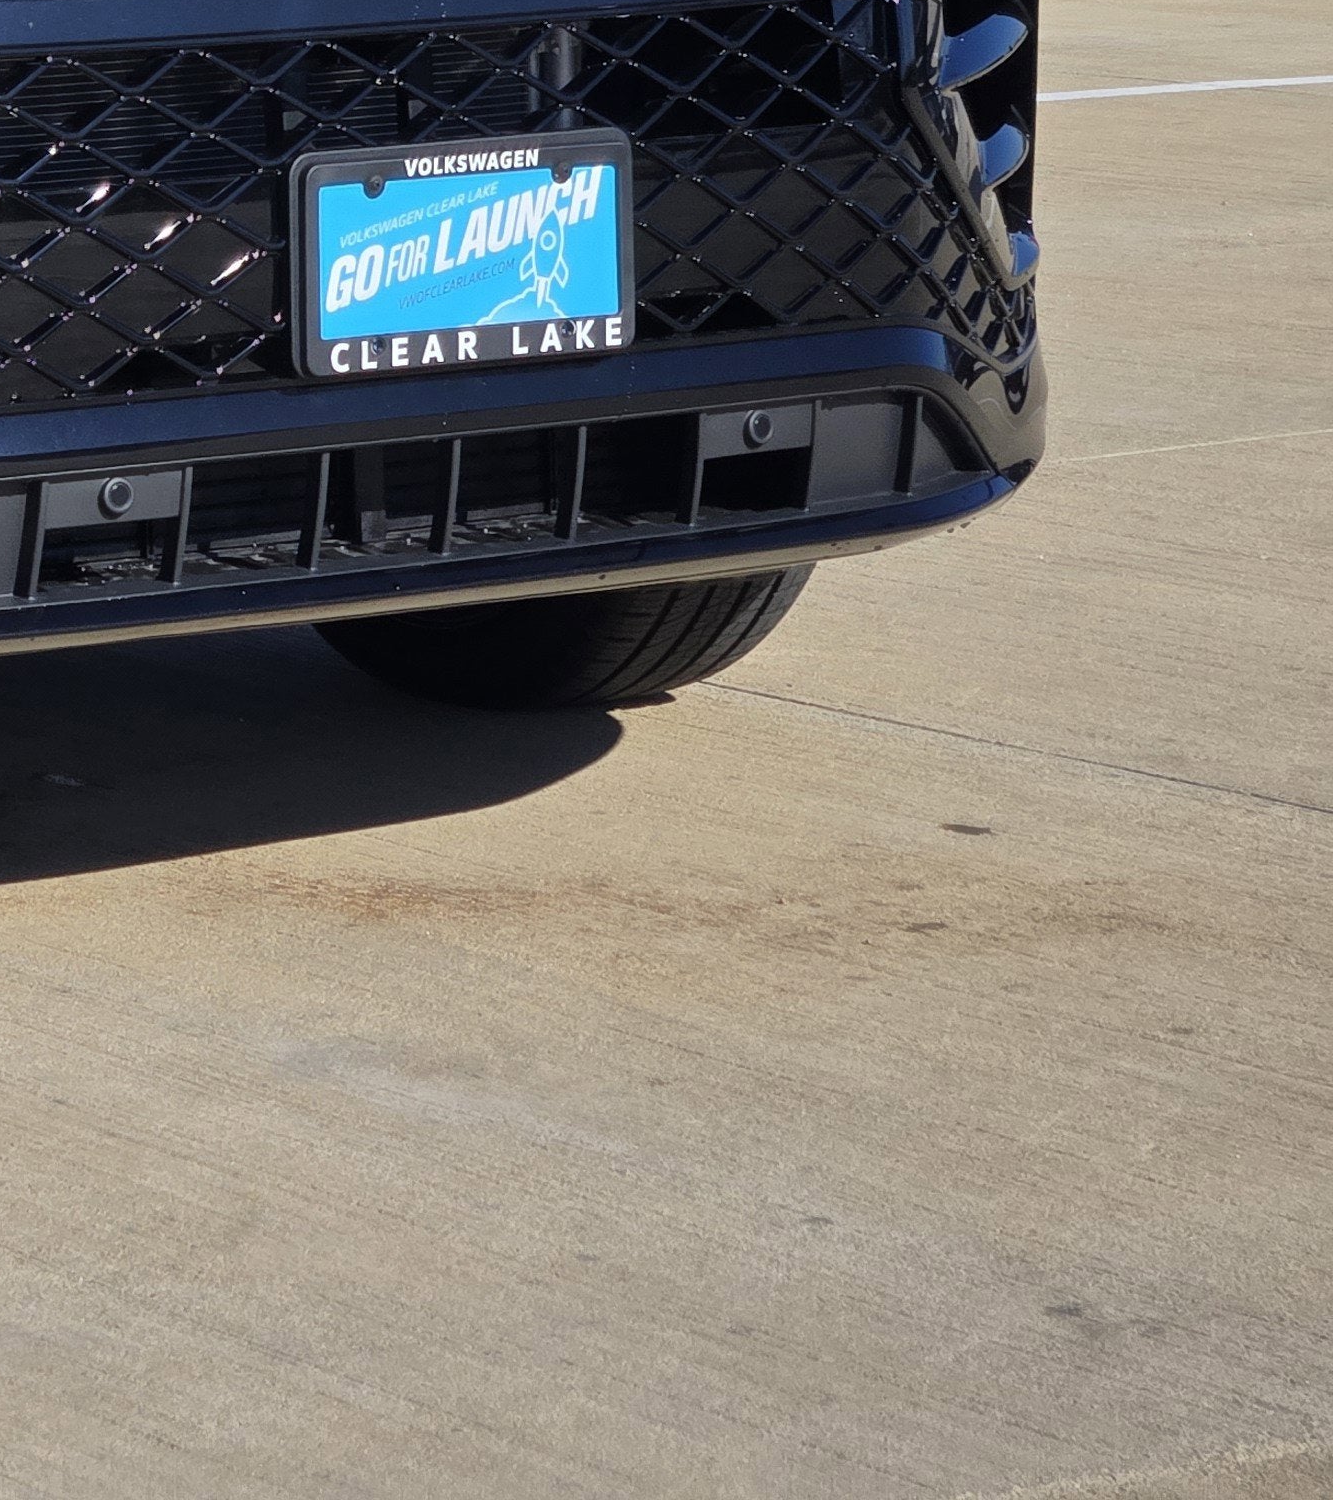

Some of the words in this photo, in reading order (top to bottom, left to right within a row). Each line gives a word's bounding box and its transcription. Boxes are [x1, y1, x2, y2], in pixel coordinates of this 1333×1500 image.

[404, 149, 539, 178] VOLKSWAGEN
[326, 245, 384, 314] GO
[385, 234, 431, 288] FOR
[433, 165, 604, 274] LAUNCH
[340, 209, 423, 248] VOLKSWAGEN
[426, 196, 466, 218] CLEAR
[467, 182, 499, 204] LAKE
[330, 331, 479, 374] CLEAR
[512, 317, 623, 356] LAKE
